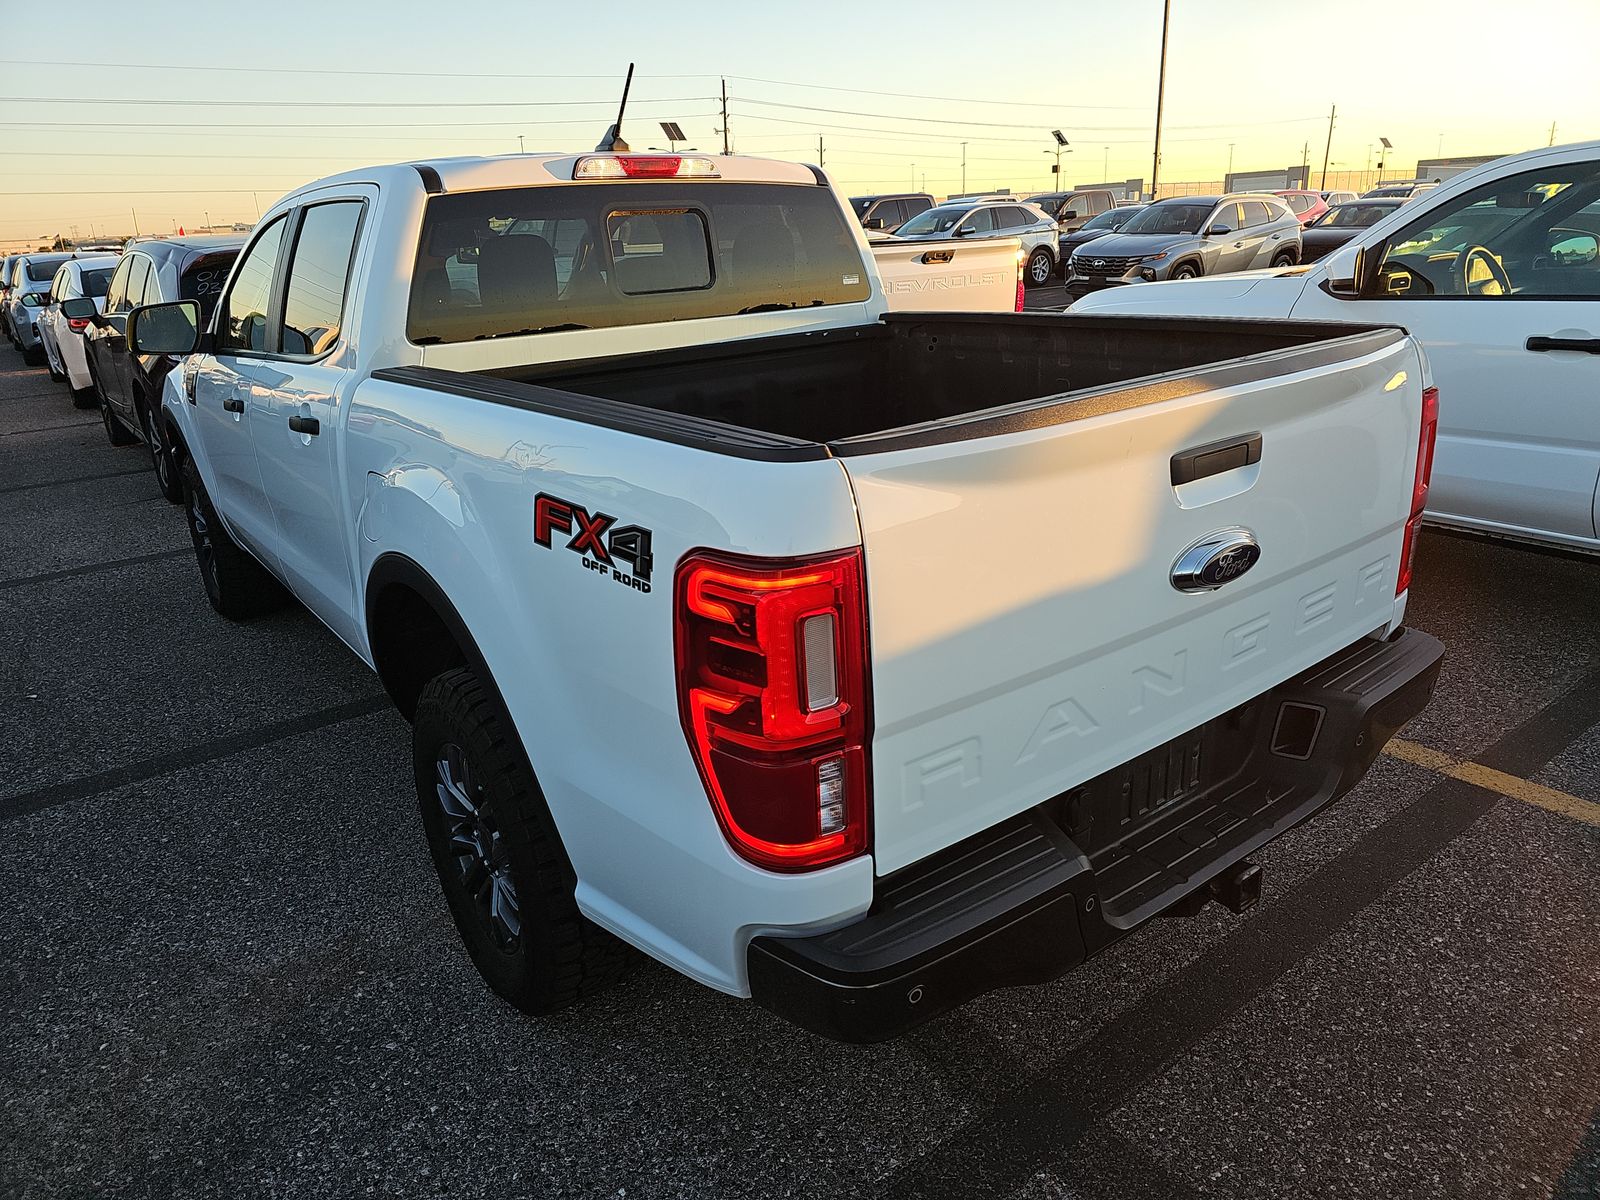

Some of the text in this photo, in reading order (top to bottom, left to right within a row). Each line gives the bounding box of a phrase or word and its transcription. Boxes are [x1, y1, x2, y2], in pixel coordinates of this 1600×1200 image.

[881, 271, 1008, 295] HEVROLET
[534, 491, 653, 583] FX4
[581, 556, 652, 594] OFF ROAD
[1214, 548, 1252, 581] Ford
[900, 552, 1392, 814] RANGER
